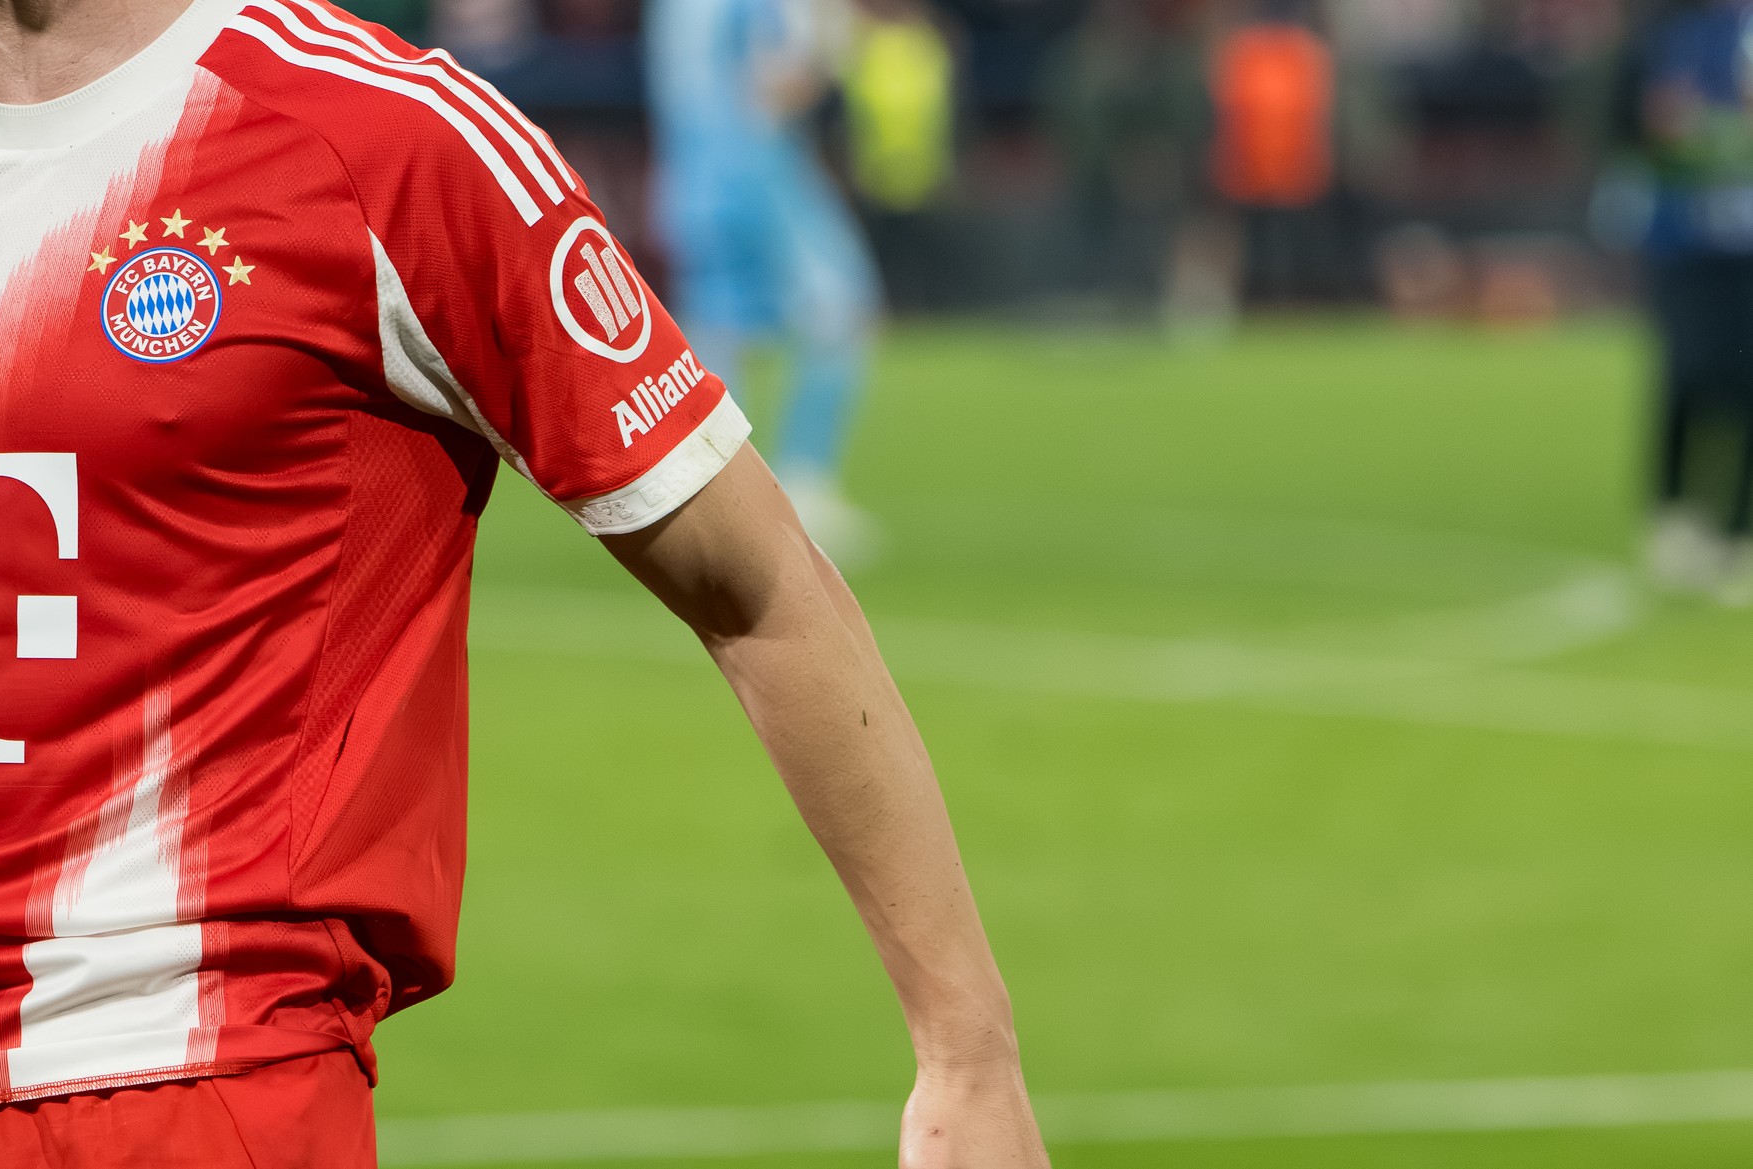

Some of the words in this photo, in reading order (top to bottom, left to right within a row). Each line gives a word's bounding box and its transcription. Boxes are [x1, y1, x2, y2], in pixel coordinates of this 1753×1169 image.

[116, 270, 139, 294] FC
[143, 256, 212, 300] BAYERN
[110, 313, 206, 354] MÜNCHEN
[610, 349, 705, 448] Allianz
